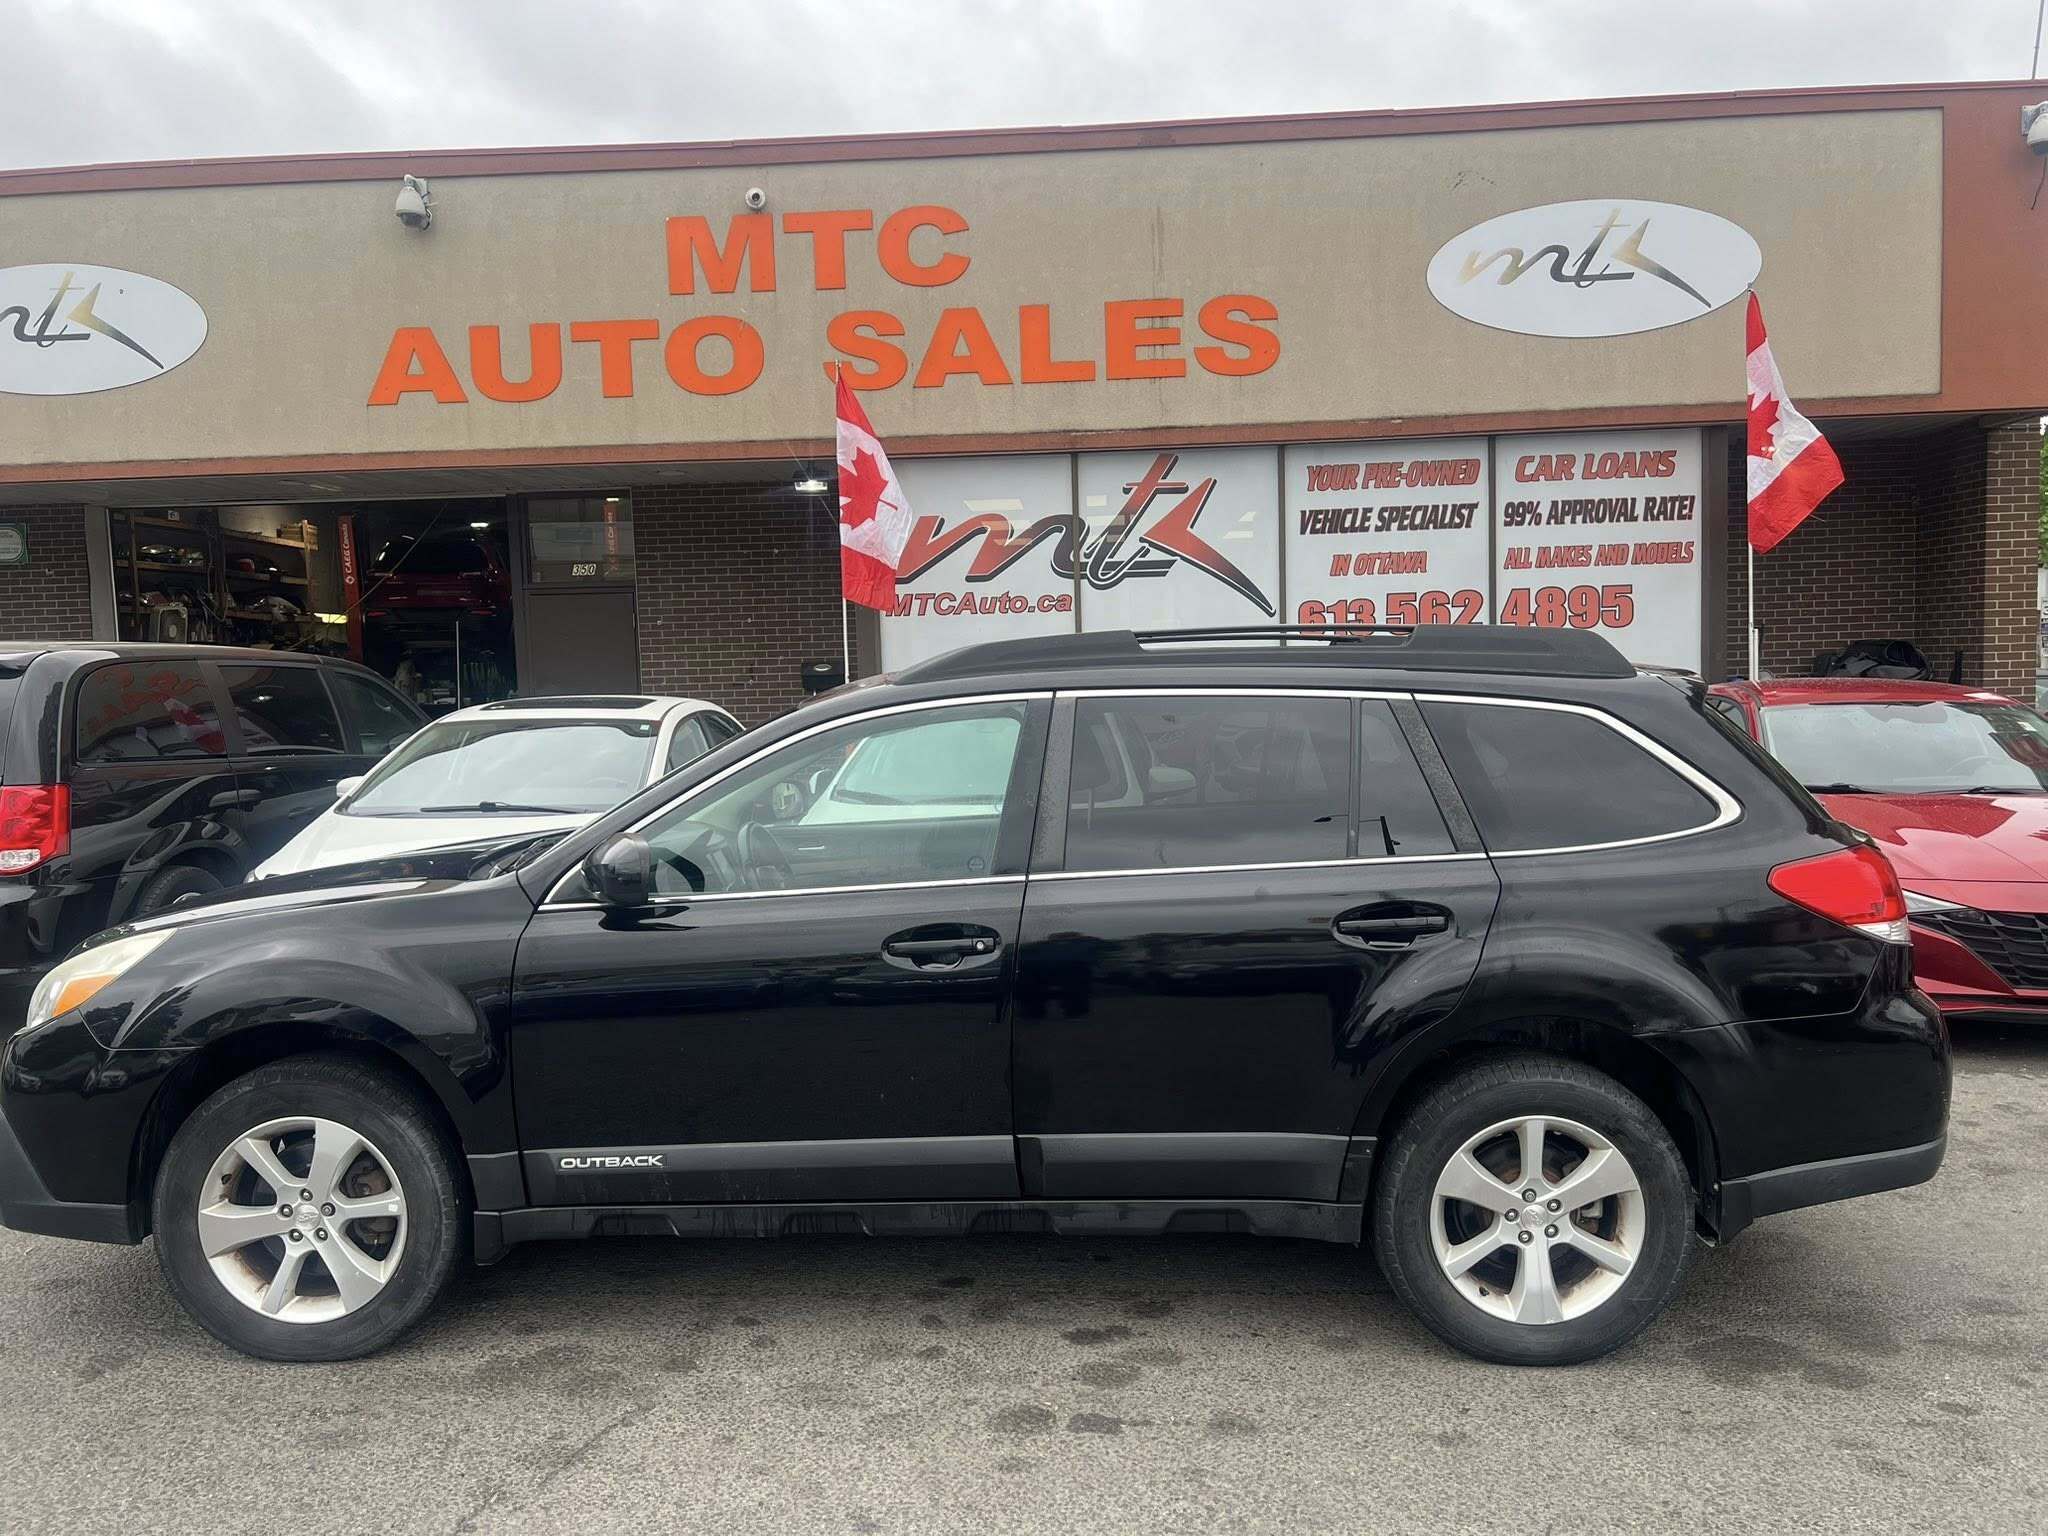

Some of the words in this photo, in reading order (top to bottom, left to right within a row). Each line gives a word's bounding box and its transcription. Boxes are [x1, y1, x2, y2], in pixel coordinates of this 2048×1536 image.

[666, 206, 971, 296] MTC
[367, 315, 765, 407] AUTO
[823, 295, 1281, 391] SALES
[1307, 464, 1360, 491] YOUR
[1362, 459, 1480, 489] PRE-OWNED
[1515, 455, 1576, 482] CAR
[1582, 450, 1677, 480] LOANS
[1300, 507, 1373, 535] VEHICLE
[1374, 502, 1479, 532] SPECIALIST
[1503, 500, 1542, 527] 99%
[1546, 497, 1638, 525] APPROVAL
[1642, 495, 1695, 521] RATE!
[572, 564, 596, 575] 350
[1329, 554, 1352, 576] IN
[1353, 551, 1428, 576] OTTAWA
[1503, 547, 1532, 569] ALL
[1535, 545, 1592, 568] MAKES
[1594, 543, 1629, 566] AND
[1631, 541, 1694, 565] MODELS
[885, 590, 1073, 616] MTCAuto.ca
[1298, 598, 1377, 636] 613
[1385, 589, 1484, 630] 562
[1500, 584, 1634, 628] 4895
[560, 1155, 664, 1169] OUTBACK
